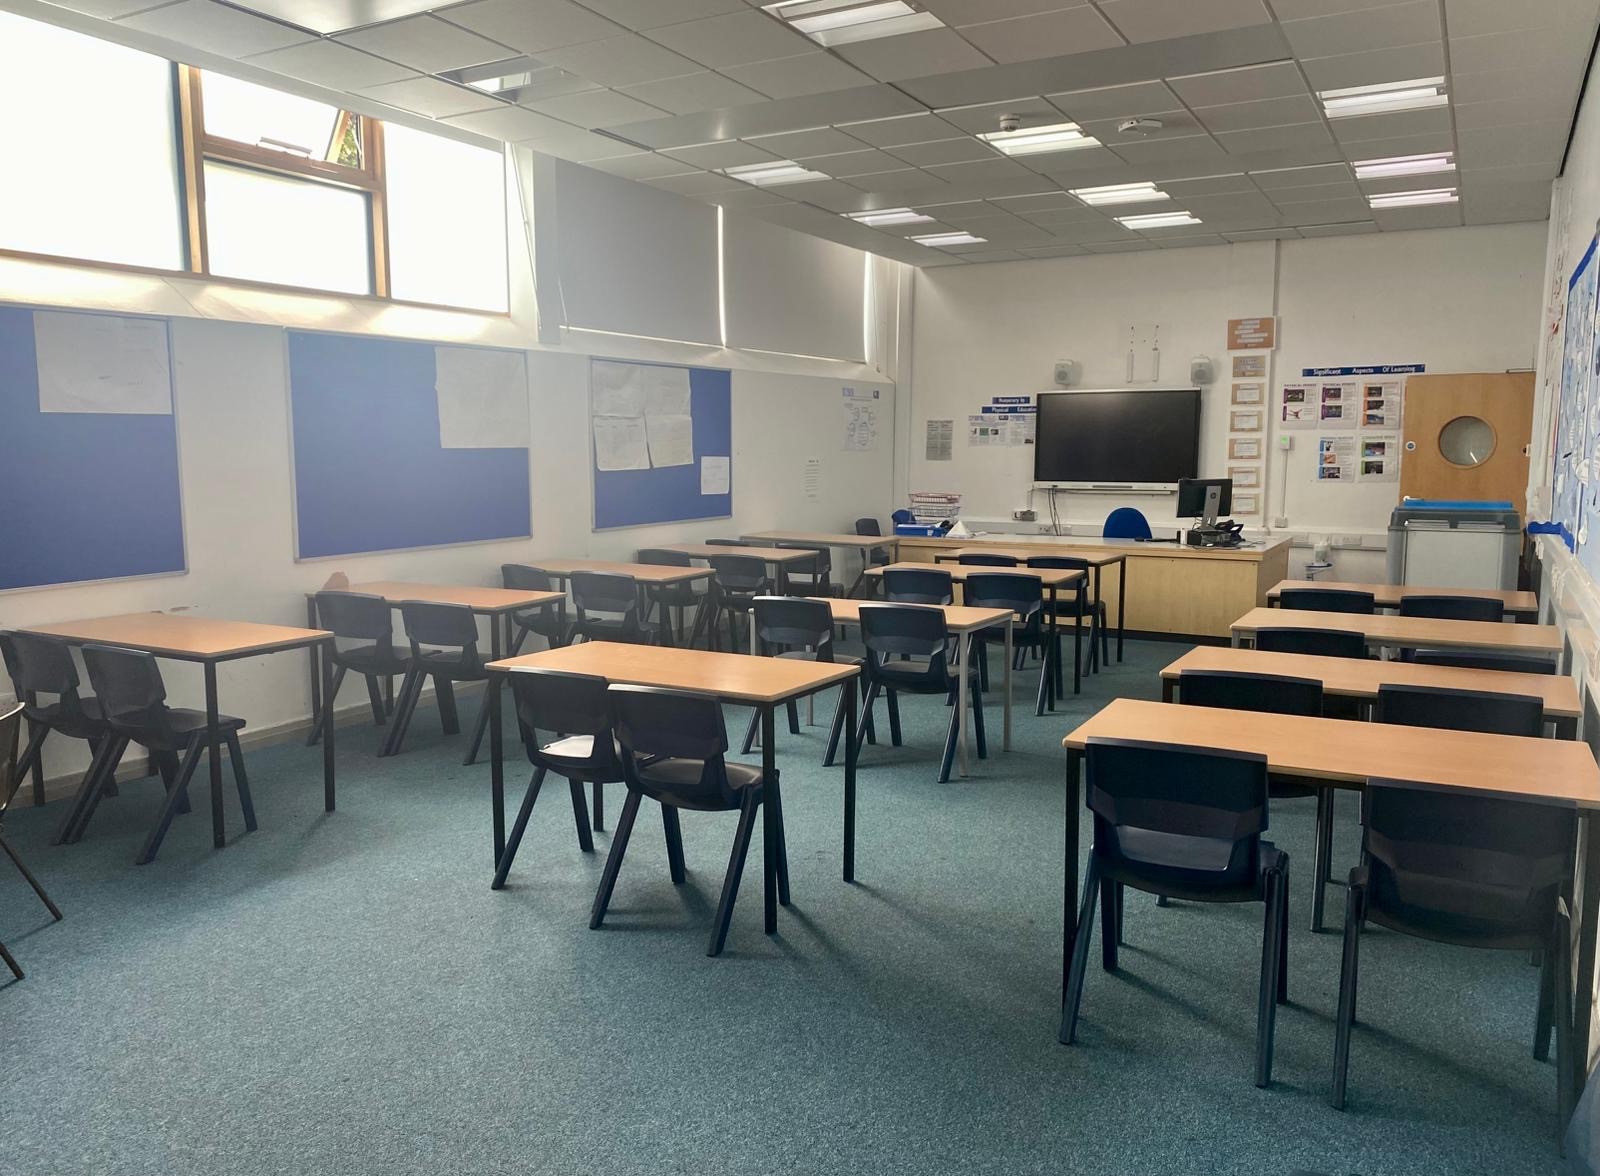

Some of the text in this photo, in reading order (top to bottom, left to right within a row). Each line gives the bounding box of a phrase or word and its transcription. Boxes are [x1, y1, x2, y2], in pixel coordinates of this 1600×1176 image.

[1313, 368, 1341, 376] Significant
[1352, 367, 1374, 375] Aspects
[1391, 366, 1416, 374] Learning
